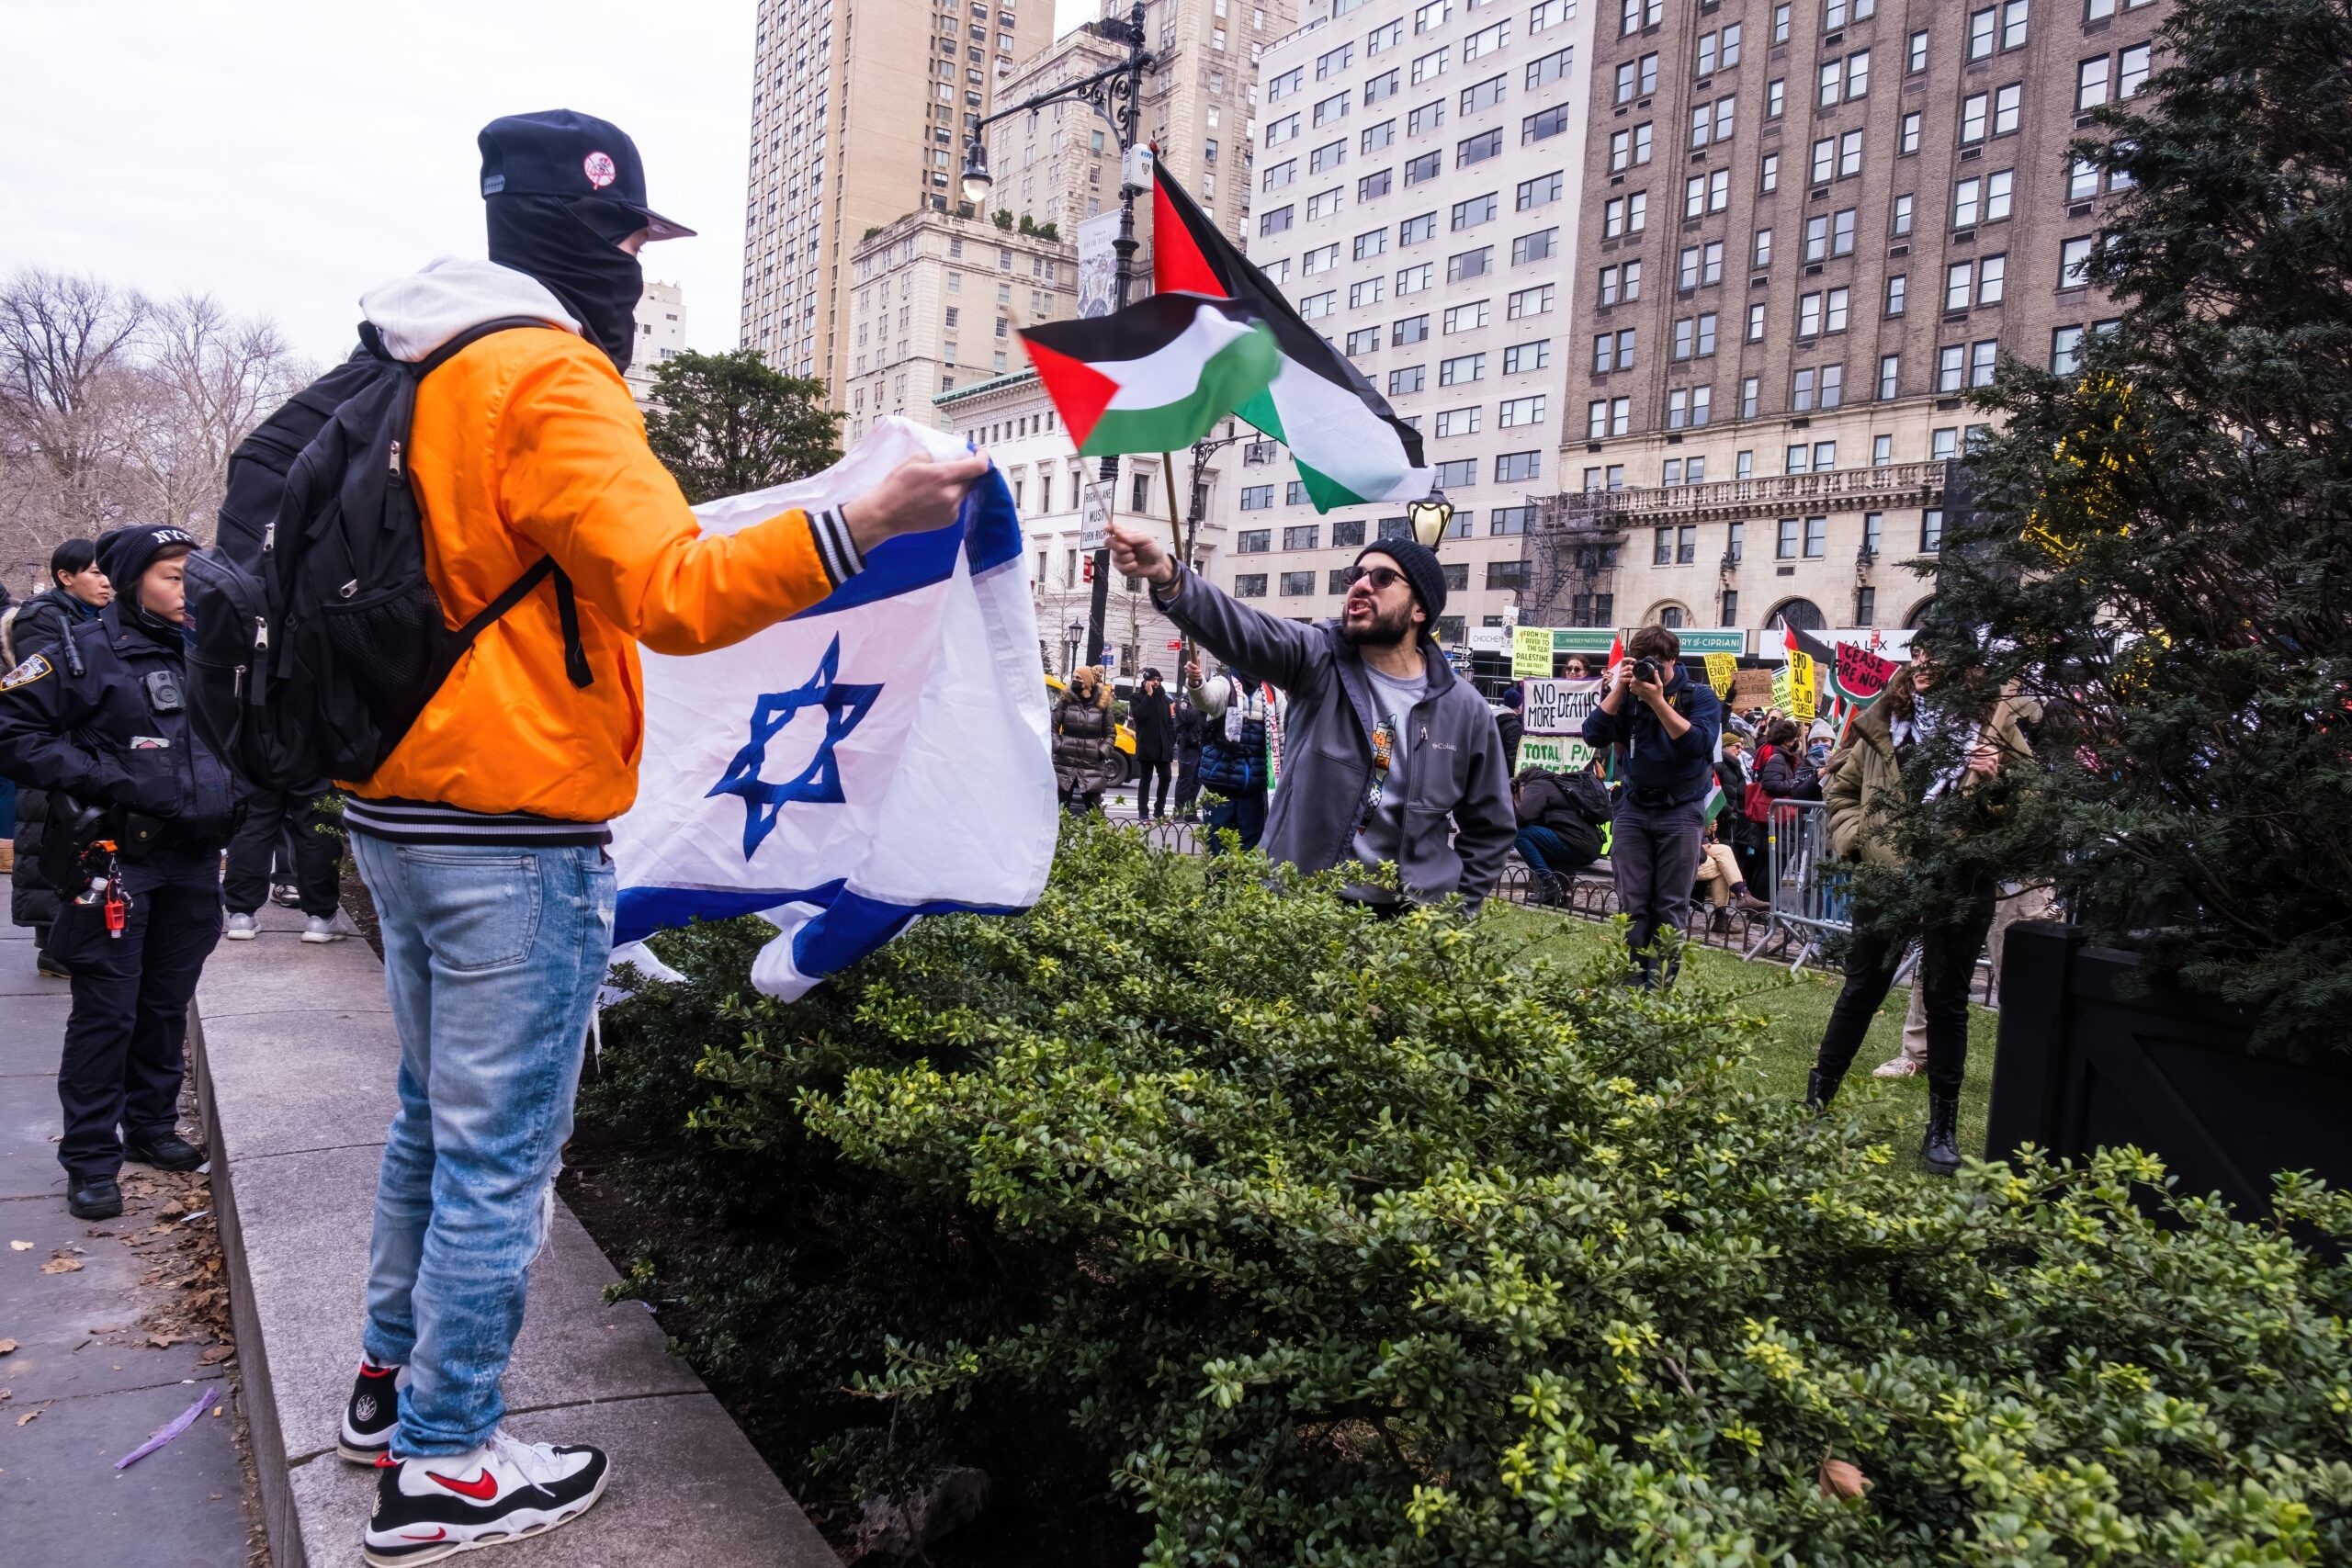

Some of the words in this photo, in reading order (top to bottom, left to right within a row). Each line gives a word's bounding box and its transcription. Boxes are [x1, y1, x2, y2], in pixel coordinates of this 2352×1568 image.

[1085, 491, 1099, 503] RIGHT
[1089, 508, 1104, 523] MUST
[151, 529, 192, 544] NYP
[1082, 530, 1095, 542] TURN
[1095, 529, 1109, 540] RIGH
[1702, 638, 1740, 648] CIPRIANI
[1516, 653, 1549, 662] PALESTINE
[1705, 653, 1724, 661] STAND
[1792, 651, 1807, 670] END
[1845, 645, 1883, 674] CEASE
[1709, 667, 1725, 677] END
[1734, 671, 1767, 682] JEWS
[1831, 659, 1858, 682] FIRE
[1859, 673, 1889, 692] NOW
[1533, 683, 1555, 705] NO
[1751, 683, 1772, 693] FREE
[1557, 691, 1600, 718] DEATHS
[1527, 706, 1556, 728] MORE
[1270, 715, 1280, 778] PALESTINE
[1523, 743, 1561, 762] TOTAL
